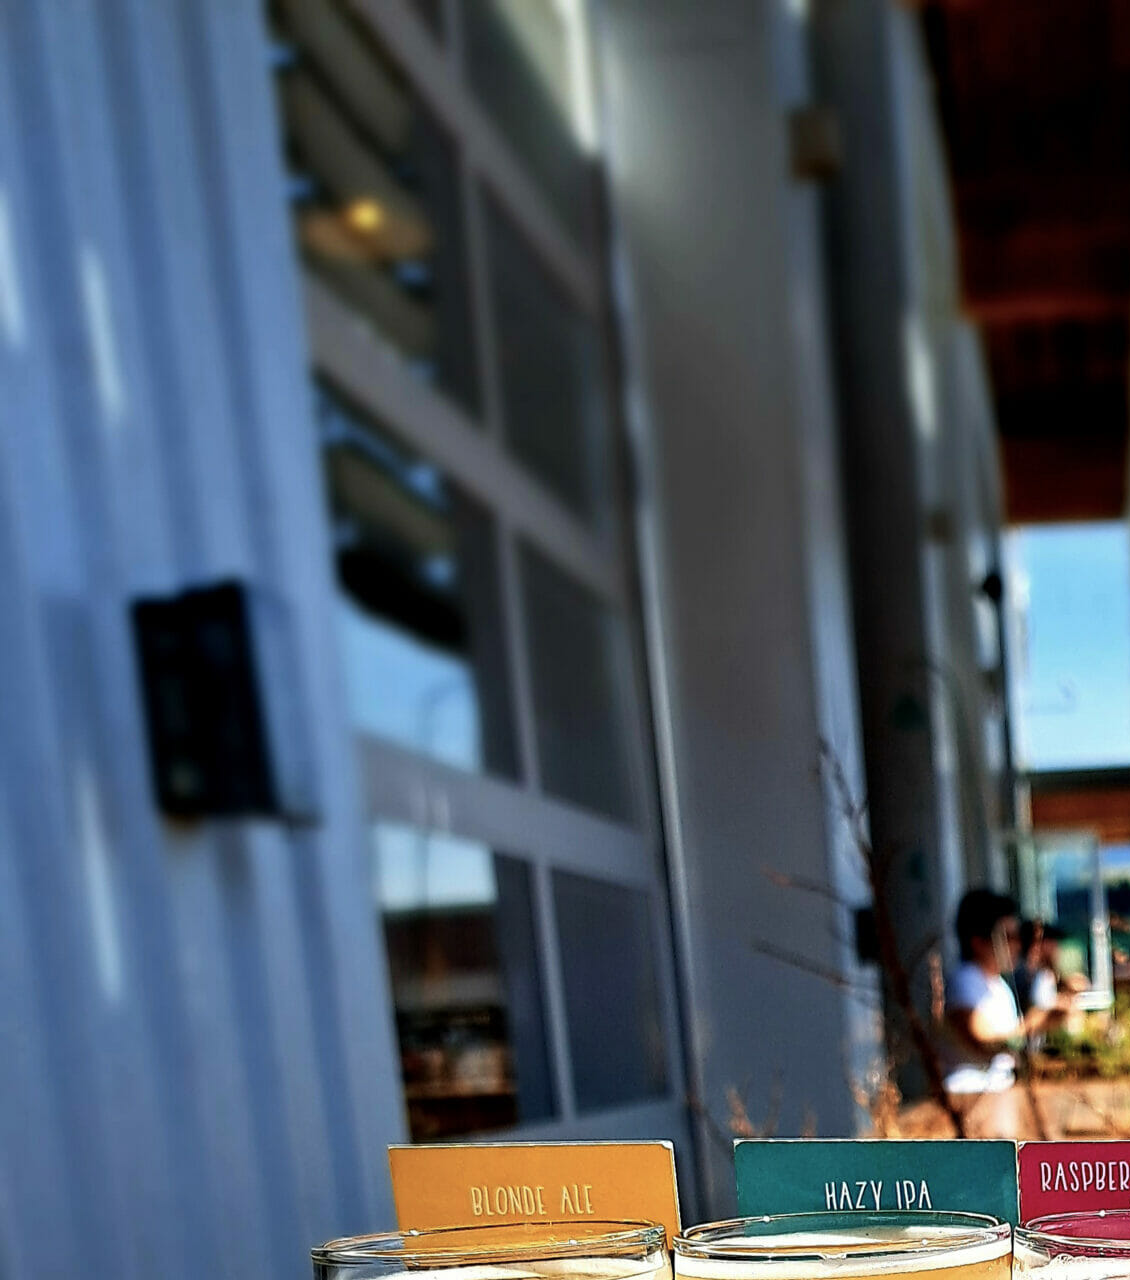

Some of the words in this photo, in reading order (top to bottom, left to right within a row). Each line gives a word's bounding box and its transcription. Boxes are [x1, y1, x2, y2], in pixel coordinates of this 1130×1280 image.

[471, 1186, 547, 1216] BLONDE
[561, 1184, 595, 1214] ALE
[825, 1180, 882, 1211] HAZY
[896, 1179, 932, 1210] IPA
